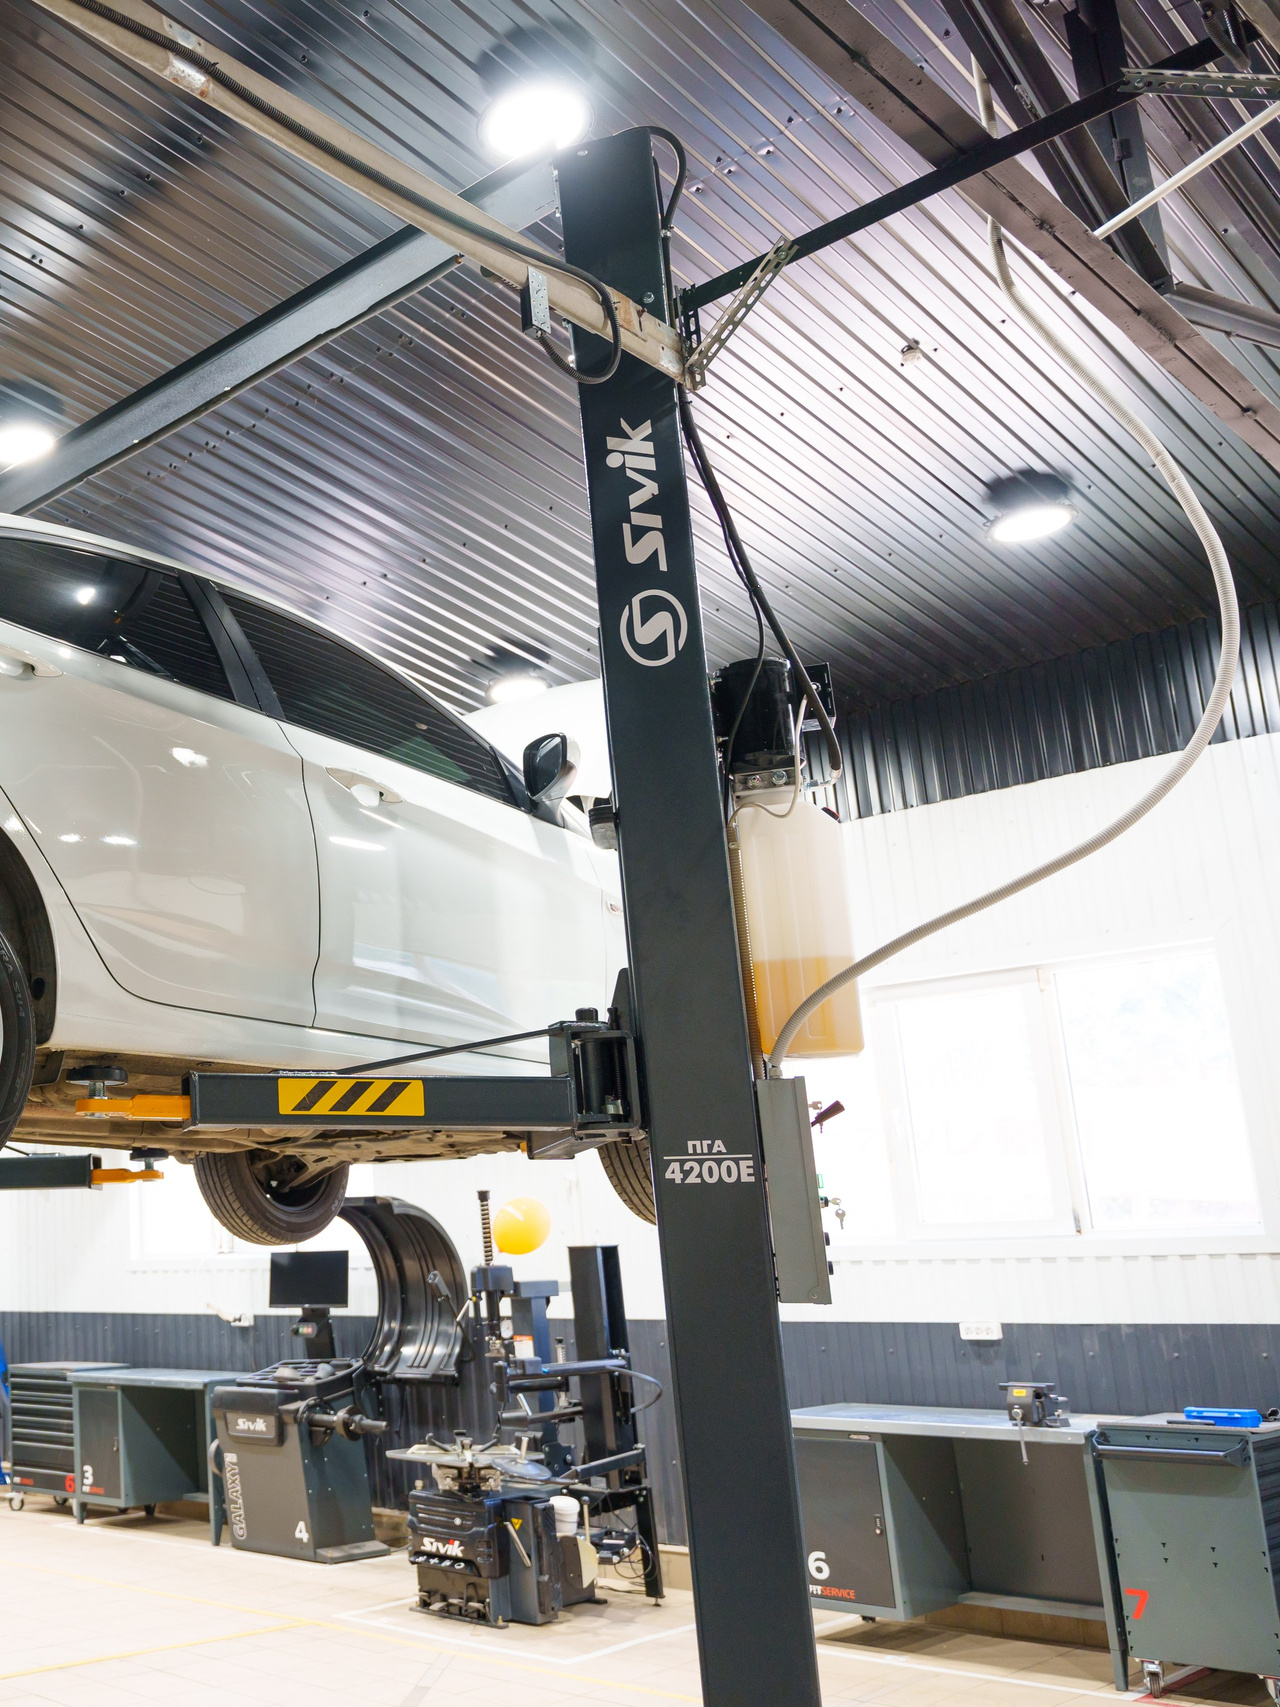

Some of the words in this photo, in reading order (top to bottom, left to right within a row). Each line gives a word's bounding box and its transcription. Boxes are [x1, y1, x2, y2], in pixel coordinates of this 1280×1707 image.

[606, 417, 668, 572] Sivik
[687, 1140, 727, 1154] ПГА
[664, 1160, 756, 1184] 4200E
[235, 1417, 267, 1432] Sivik
[65, 1475, 75, 1493] 6
[82, 1465, 94, 1485] 3
[225, 1459, 247, 1540] GALAXY
[295, 1521, 309, 1543] 4
[420, 1537, 465, 1557] Sivik
[808, 1551, 830, 1580] 6
[1125, 1588, 1149, 1620] 7
